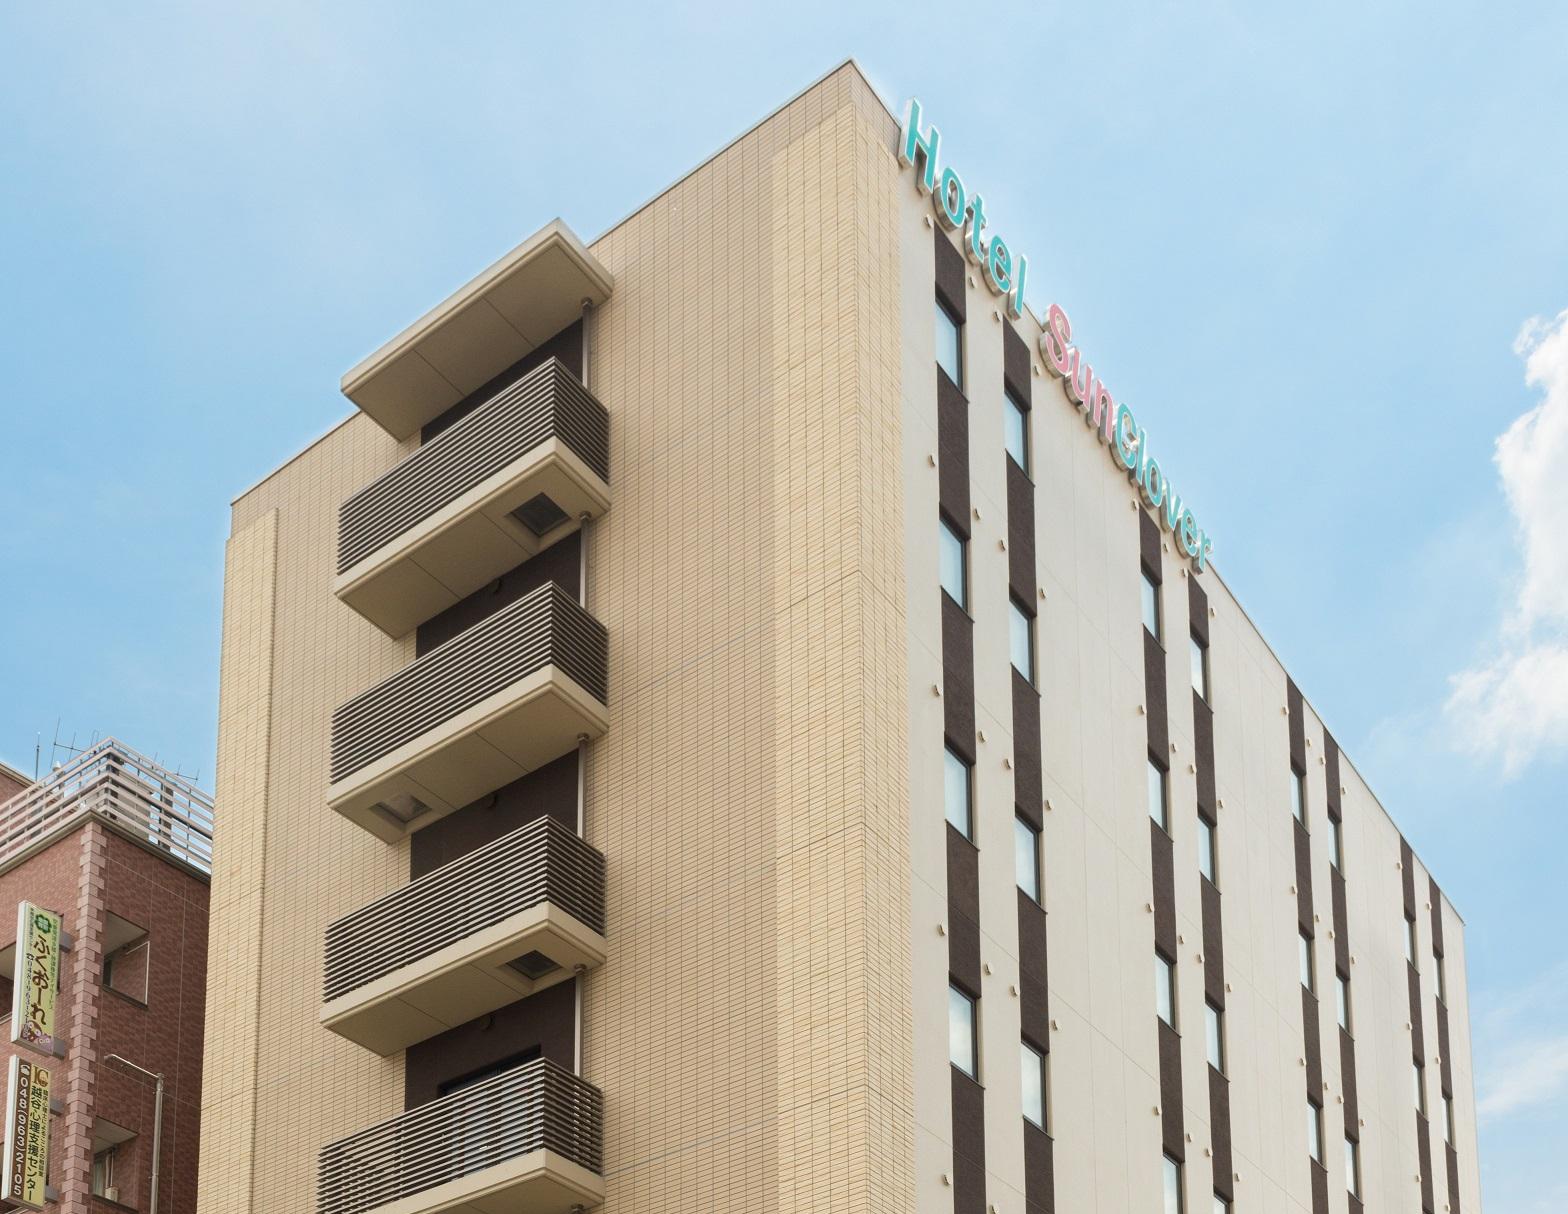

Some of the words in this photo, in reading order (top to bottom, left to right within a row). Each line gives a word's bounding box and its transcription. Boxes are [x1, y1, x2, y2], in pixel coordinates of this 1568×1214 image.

[902, 97, 1028, 314] Hotel
[1043, 304, 1212, 573] SunClover
[31, 934, 50, 1025] ふくおーれ
[14, 1077, 28, 1195] 048(963)2105
[26, 1085, 42, 1200] 越谷心理支援センター
